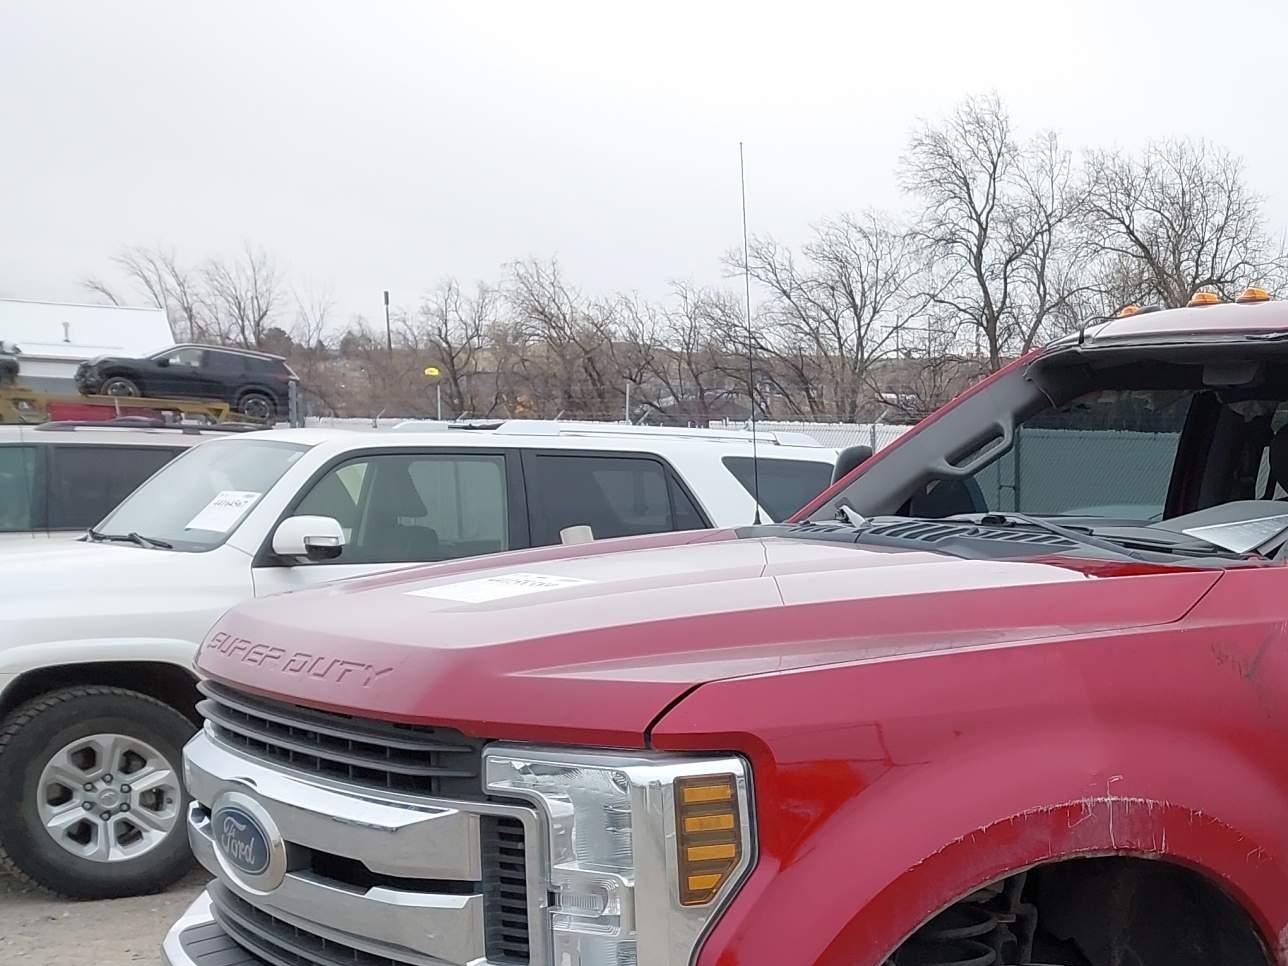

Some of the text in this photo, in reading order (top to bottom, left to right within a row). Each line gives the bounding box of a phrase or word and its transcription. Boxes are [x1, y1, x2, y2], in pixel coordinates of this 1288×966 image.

[207, 631, 394, 687] SUPER DUTY
[221, 816, 256, 865] Ford
